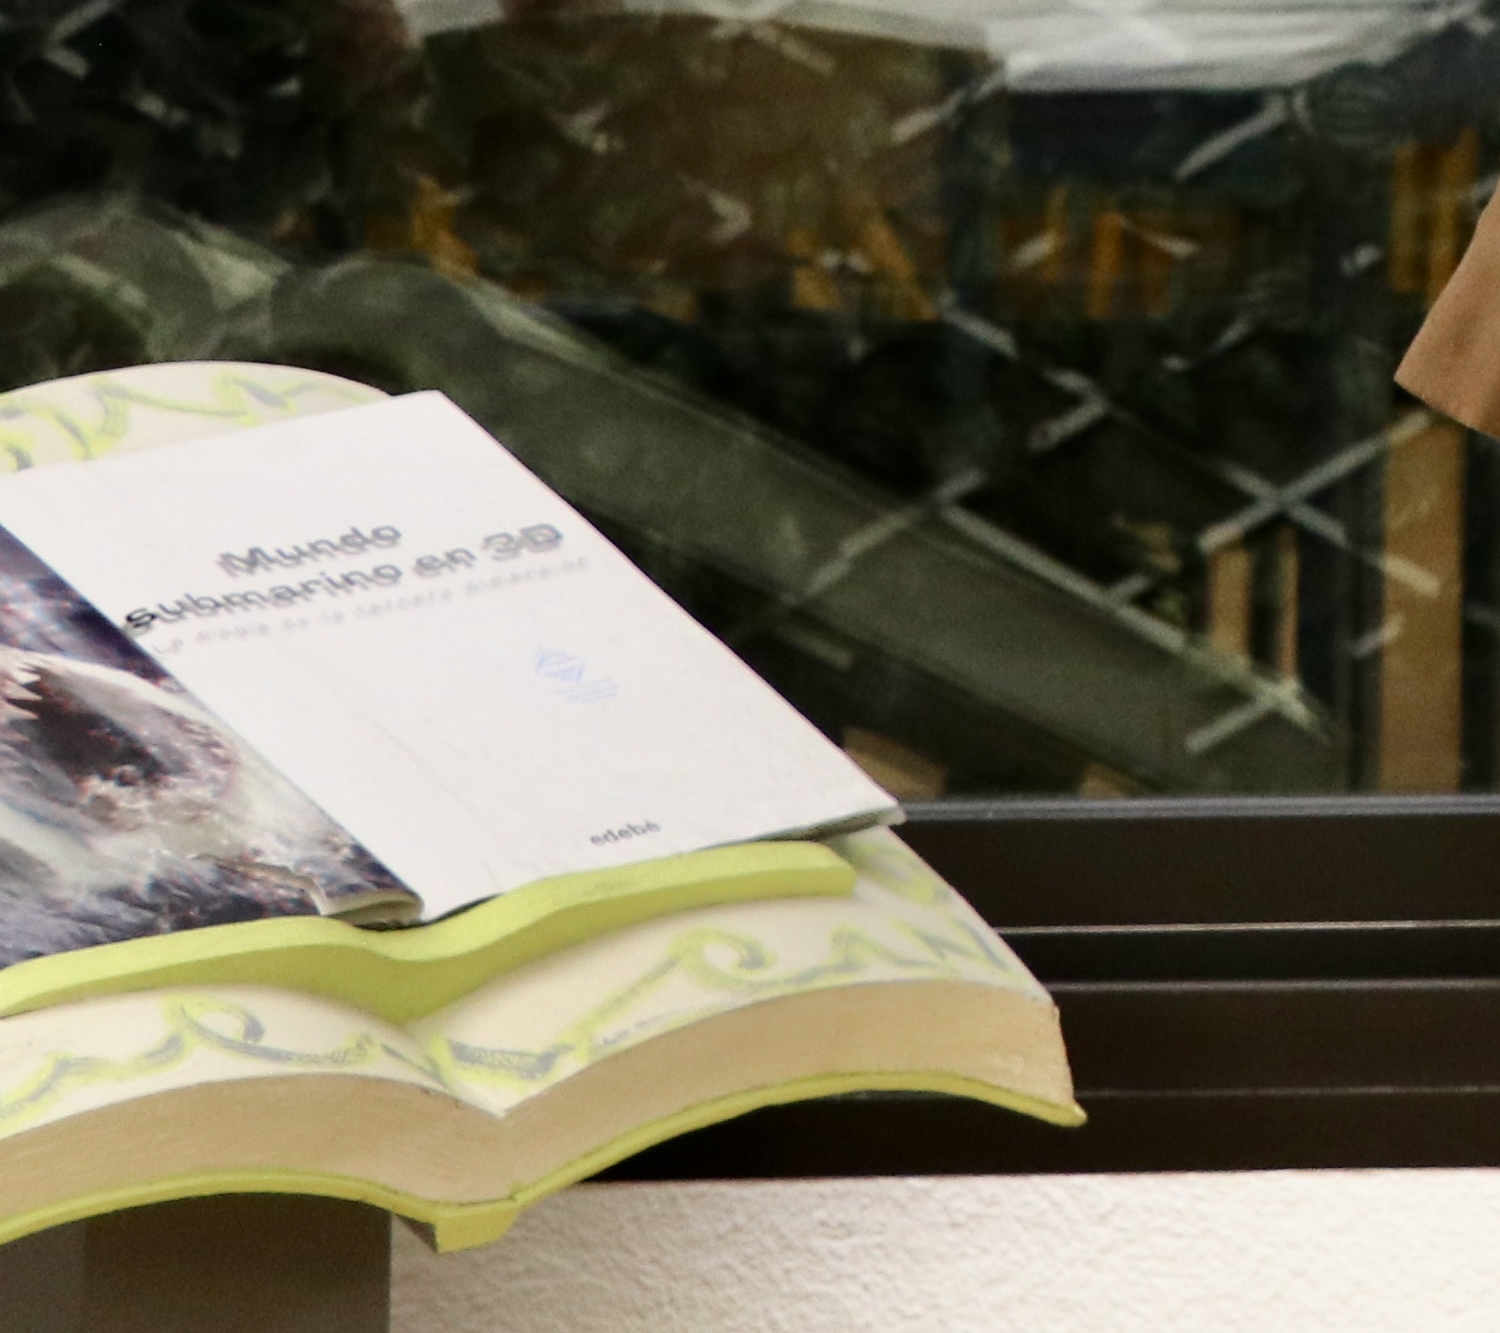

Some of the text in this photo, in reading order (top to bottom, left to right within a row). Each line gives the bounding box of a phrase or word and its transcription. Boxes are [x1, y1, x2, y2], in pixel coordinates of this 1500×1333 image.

[124, 562, 404, 633] submarino
[412, 545, 477, 579] en
[482, 522, 565, 562] 3D
[217, 523, 403, 578] Mundo
